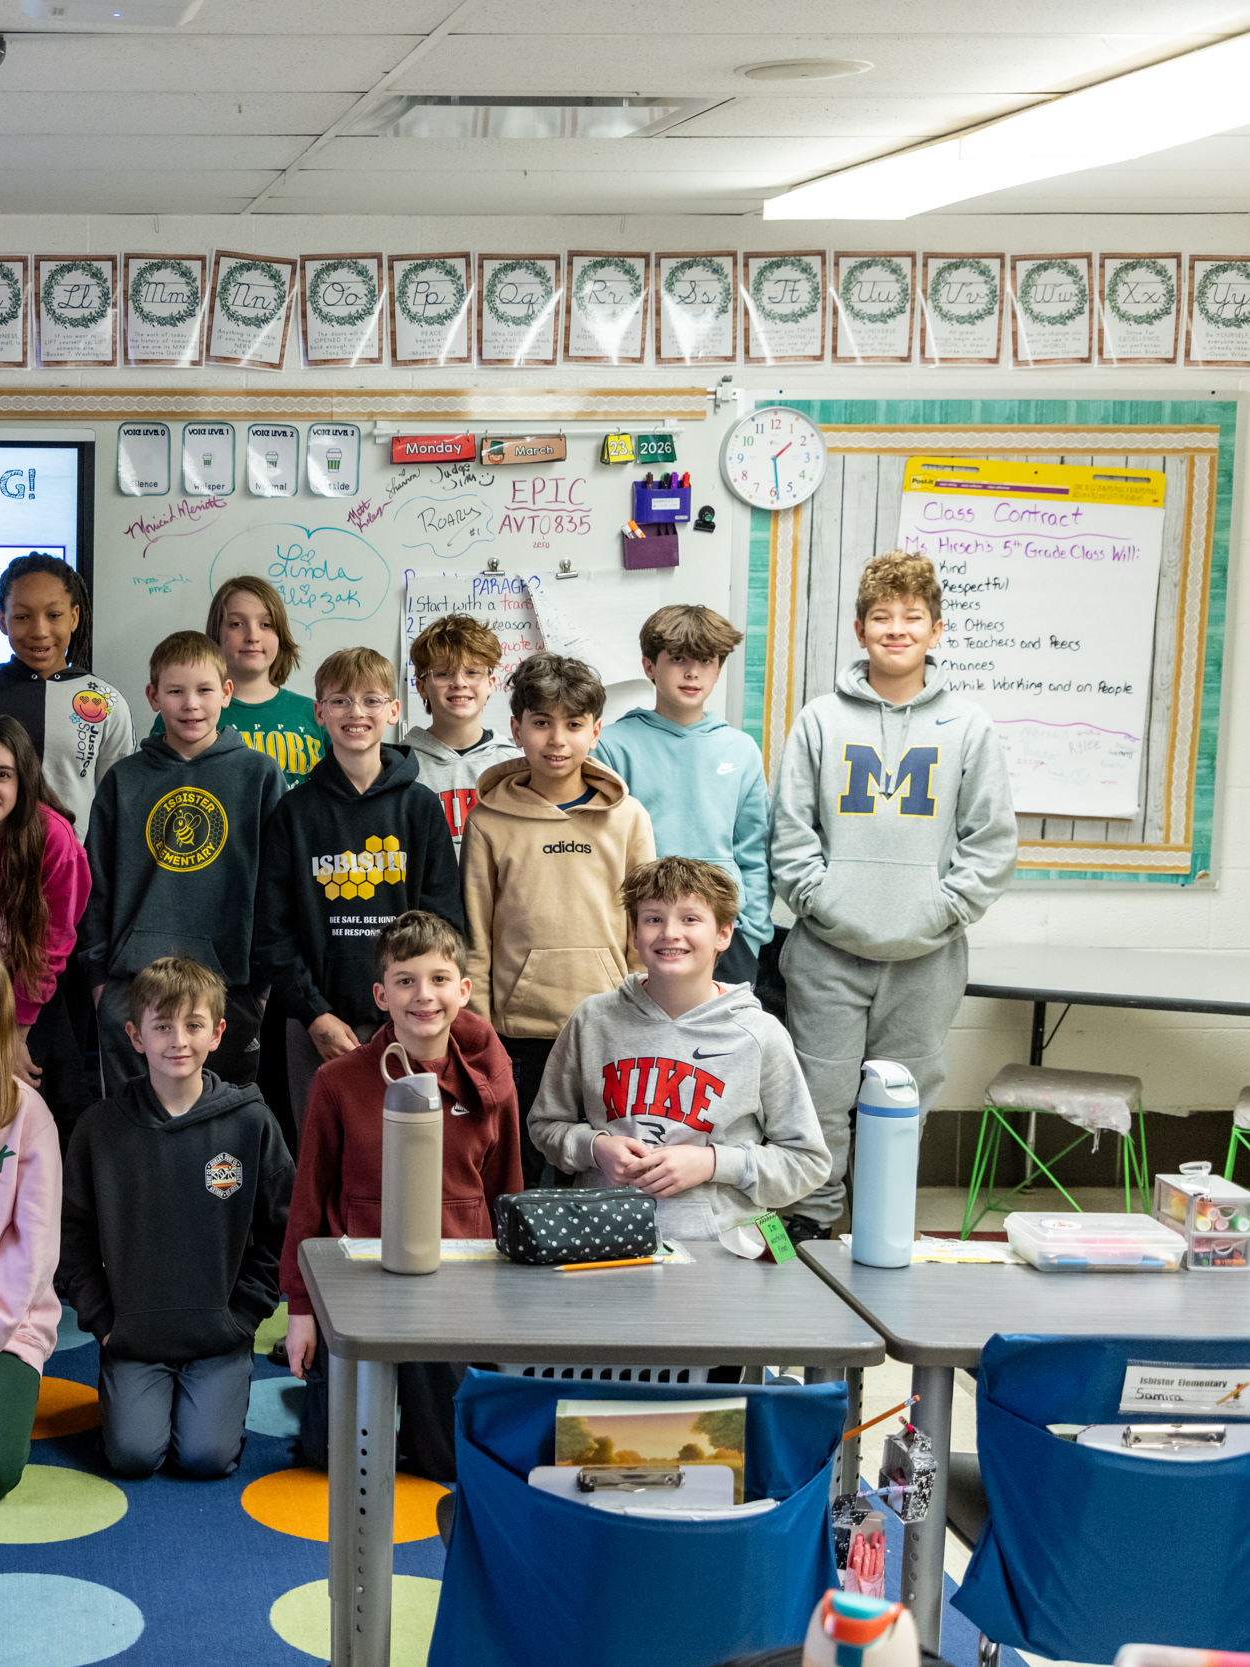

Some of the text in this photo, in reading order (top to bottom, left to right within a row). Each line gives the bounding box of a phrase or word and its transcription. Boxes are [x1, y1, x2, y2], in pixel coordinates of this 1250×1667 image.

[58, 284, 93, 308] Ll
[144, 282, 189, 303] Mm
[231, 282, 272, 309] Nn
[323, 282, 363, 306] Oo
[413, 281, 446, 317] Pp
[500, 283, 539, 315] Qq
[588, 280, 624, 304] Rr
[676, 280, 717, 304] Ss
[768, 279, 802, 303] Tt
[852, 281, 896, 302] Uu
[942, 282, 986, 303] Vv
[1031, 283, 1076, 303] Ww
[1122, 282, 1161, 303] Xx
[1208, 283, 1250, 315] Yy
[123, 429, 160, 437] VOICE LEVEL
[188, 428, 225, 436] VOICE LEVEL
[312, 429, 349, 437] VOICE LEVEL
[755, 423, 764, 434] 11
[770, 419, 781, 430] 12
[790, 423, 794, 434] 1
[406, 442, 462, 455] Monday
[640, 442, 672, 454] 2026
[742, 436, 754, 446] 10
[800, 436, 807, 446] 2
[515, 446, 554, 456] March
[737, 453, 744, 464] 9
[804, 453, 810, 463] 3
[741, 470, 748, 481] 8
[799, 469, 806, 480] 4
[130, 480, 158, 489] Silence
[193, 482, 225, 493] Whisper
[255, 483, 287, 491] Normal
[512, 478, 586, 506] EPIC
[753, 482, 760, 493] 7
[786, 482, 793, 492] 5
[923, 501, 1083, 527] Class Contract
[498, 514, 591, 535] AVT0835
[1002, 540, 1023, 558] 5th
[1024, 542, 1066, 559] Grade
[1070, 544, 1105, 561] Class
[1112, 545, 1140, 562] Will:
[939, 560, 966, 575] Kind
[942, 577, 1009, 596] Respectful
[416, 595, 496, 613] Start with a
[940, 599, 980, 610] Others
[965, 619, 1004, 632] Others
[946, 635, 1080, 651] to Teachers and Peers
[993, 676, 1043, 695] Working
[1049, 680, 1071, 692] and
[1077, 683, 1092, 691] on
[1098, 681, 1133, 696] People
[76, 722, 91, 761] Sport
[80, 725, 99, 778] Justice
[837, 742, 941, 818] M
[163, 793, 215, 813] ISBISTER
[542, 840, 592, 854] adidas
[312, 851, 407, 877] ISBISTER
[330, 916, 377, 924] BEE SAFE. BEE
[602, 1057, 726, 1134] NIKE
[1140, 1377, 1227, 1388] Isbister Elementary
